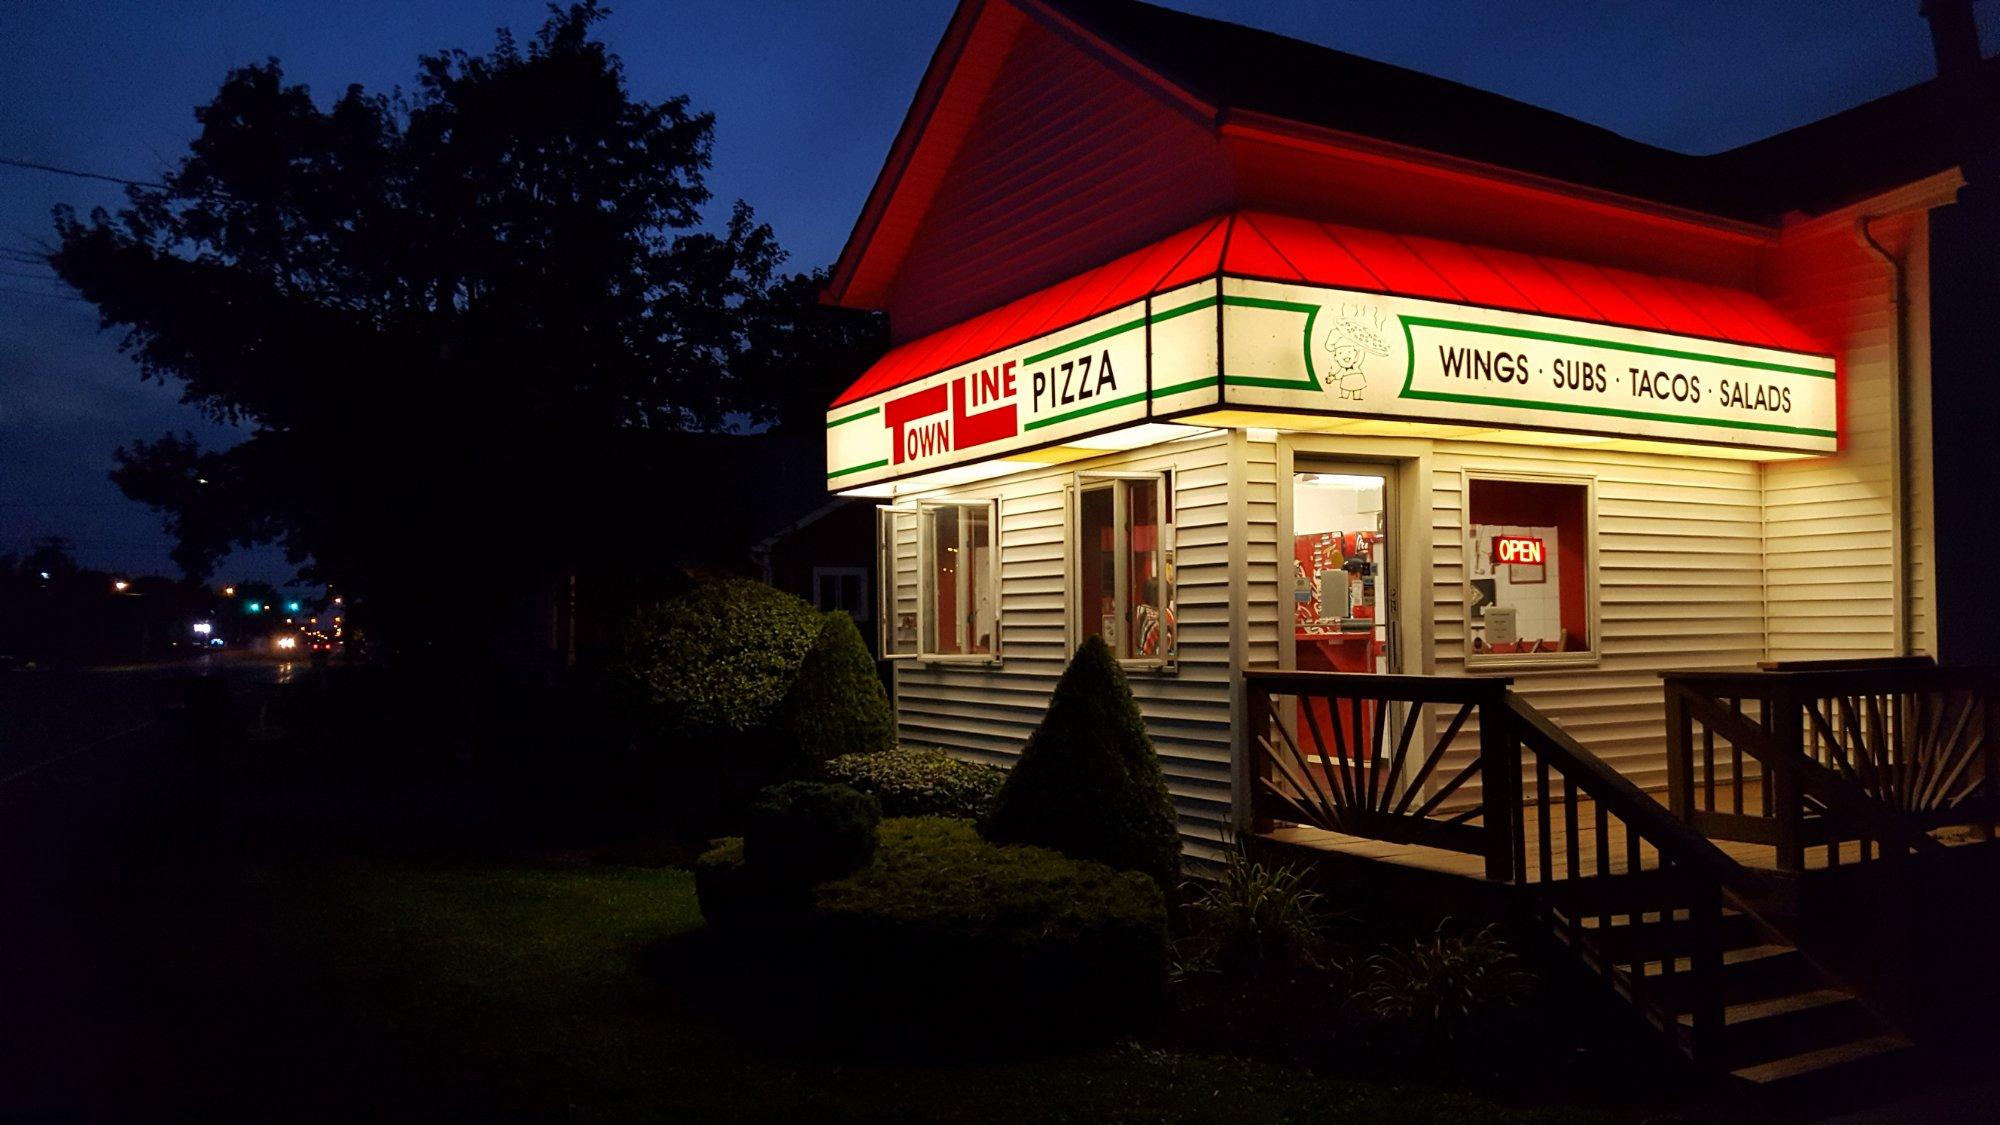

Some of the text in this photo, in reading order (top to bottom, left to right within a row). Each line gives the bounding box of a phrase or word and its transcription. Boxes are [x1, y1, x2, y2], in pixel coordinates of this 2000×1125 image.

[885, 350, 1117, 466] TOWN LINE PIZZA
[1439, 345, 1791, 414] WINGS SUBS TACOS SALADS
[1499, 539, 1542, 563] OPEN
